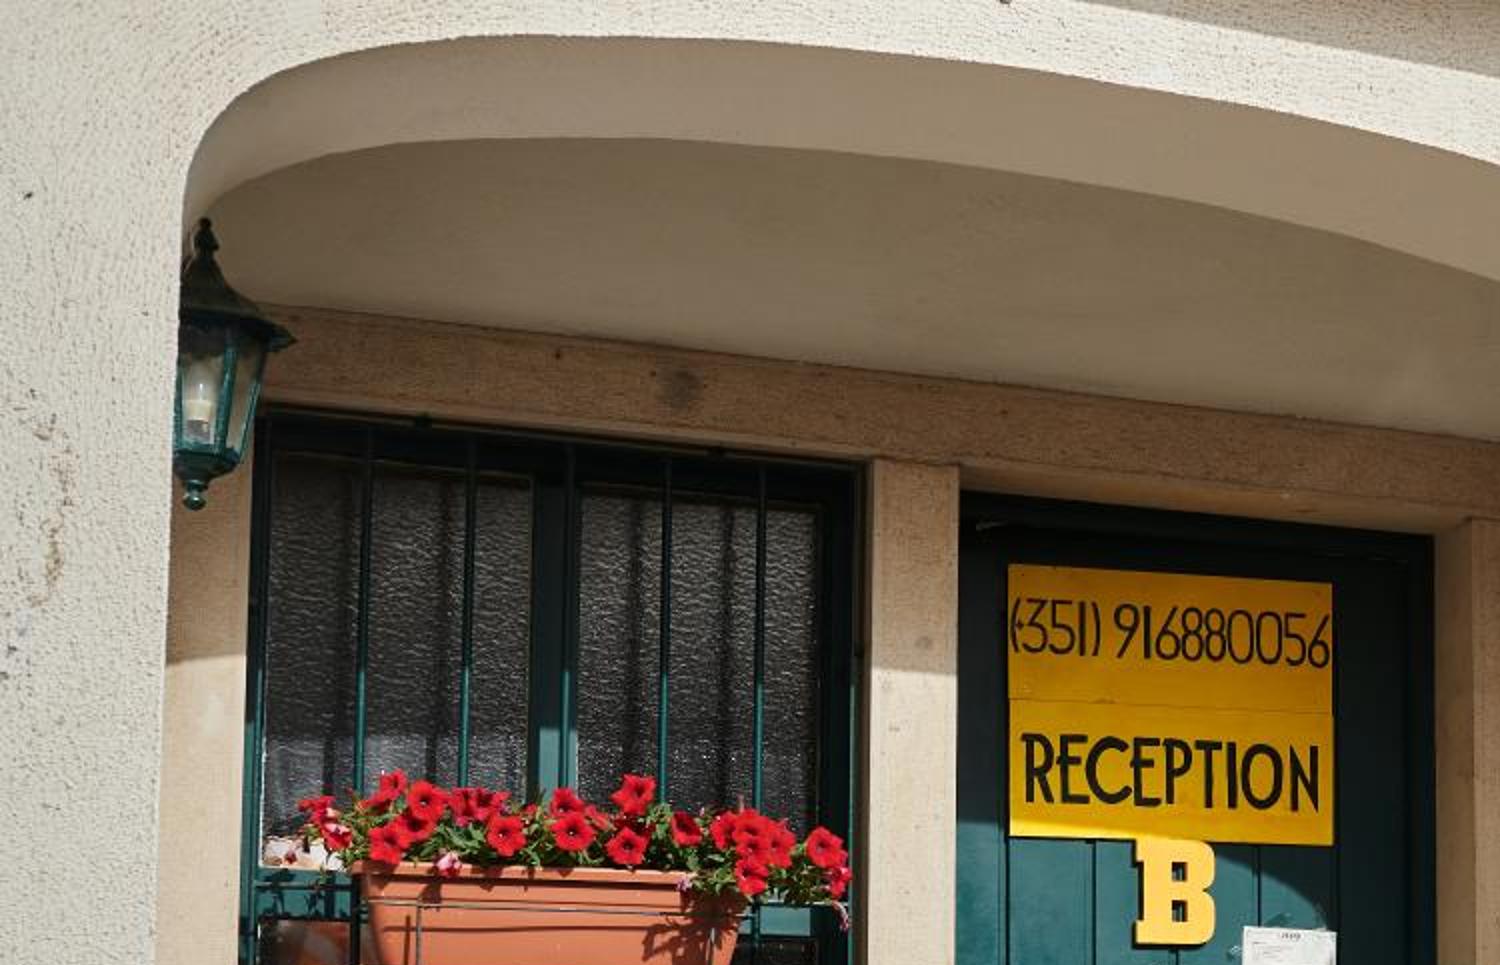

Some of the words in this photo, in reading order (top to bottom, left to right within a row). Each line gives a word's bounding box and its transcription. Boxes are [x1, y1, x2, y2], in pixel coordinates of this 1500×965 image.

[1113, 602, 1330, 668] 916880056
[1020, 732, 1319, 813] RECEPTION
[1134, 835, 1217, 945] B
